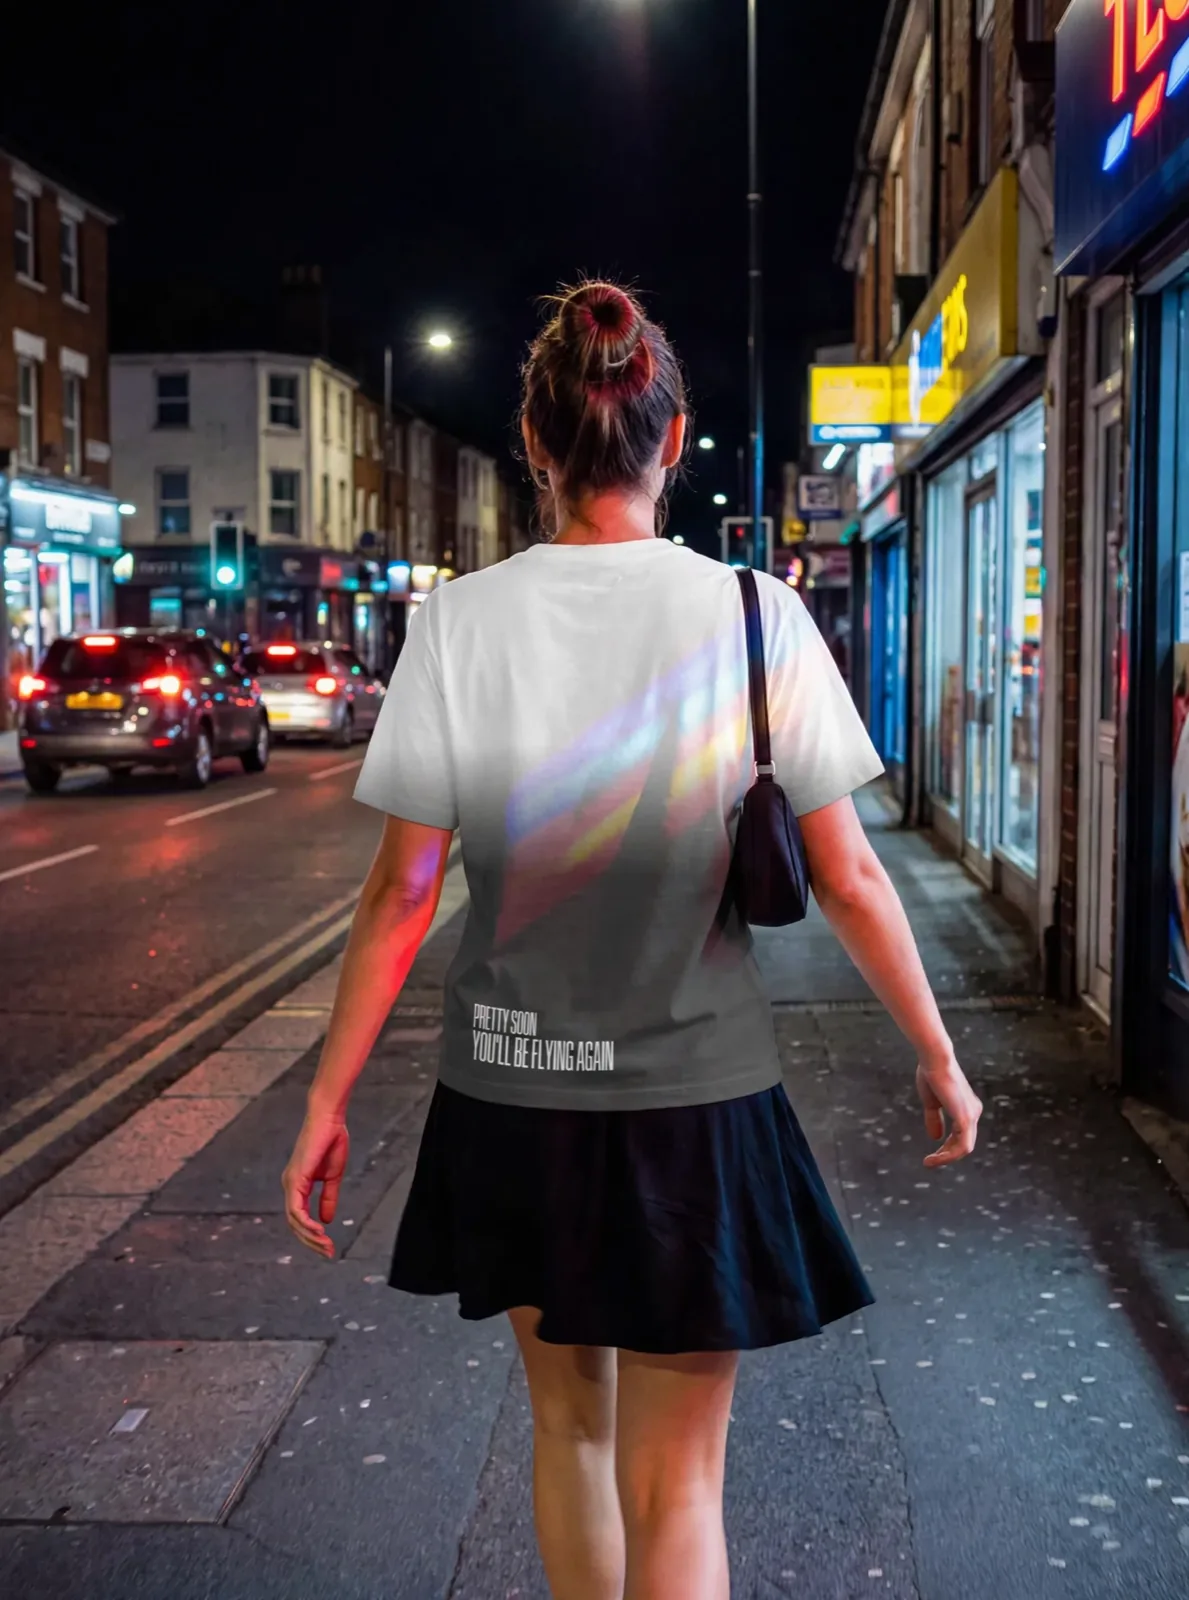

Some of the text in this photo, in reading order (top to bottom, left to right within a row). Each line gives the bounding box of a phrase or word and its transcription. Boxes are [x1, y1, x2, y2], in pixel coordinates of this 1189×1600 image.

[473, 1003, 537, 1036] PRETTY SOON
[473, 1030, 614, 1071] YOU'LL BE FLYING AGAIN
